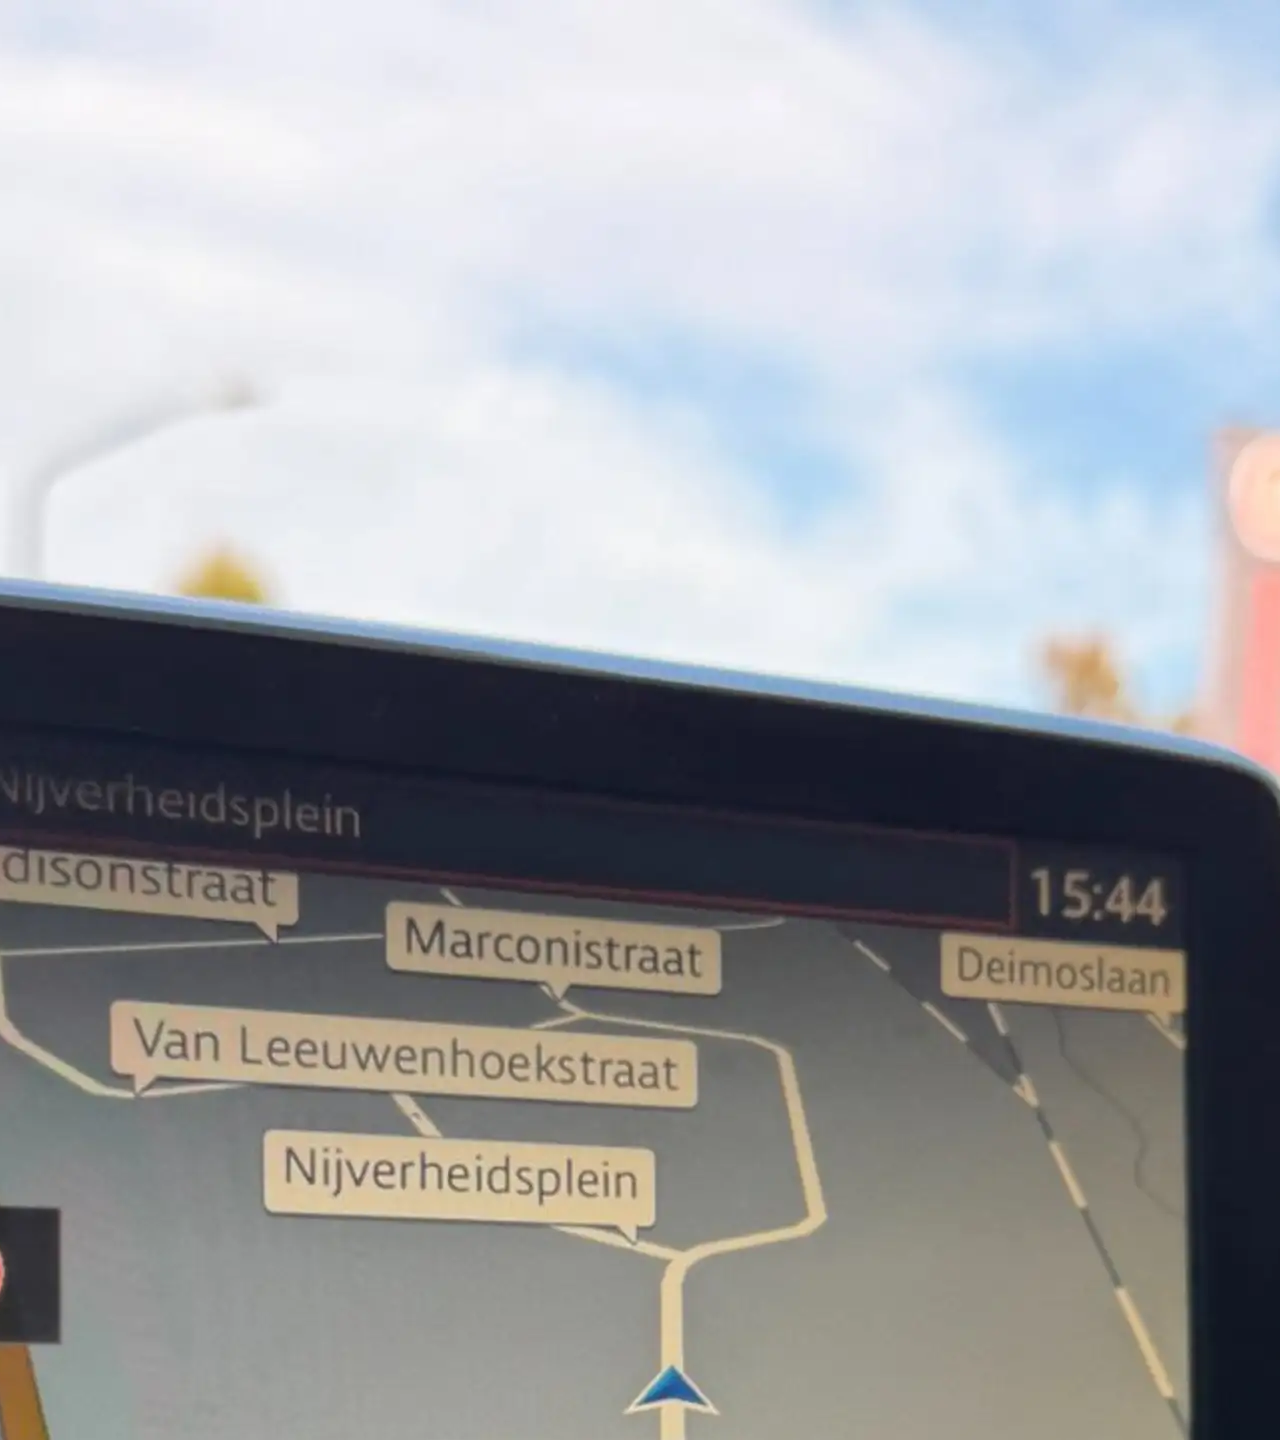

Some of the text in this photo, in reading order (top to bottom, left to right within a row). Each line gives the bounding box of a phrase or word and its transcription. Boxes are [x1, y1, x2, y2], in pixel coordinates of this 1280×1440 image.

[1030, 866, 1168, 925] 15:44
[405, 916, 703, 978] Marconistraat
[957, 946, 1171, 996] Deimoslaan
[132, 1017, 679, 1091] Van Leeuwenhoekstraat
[284, 1146, 638, 1205] Nijverheidsplein
